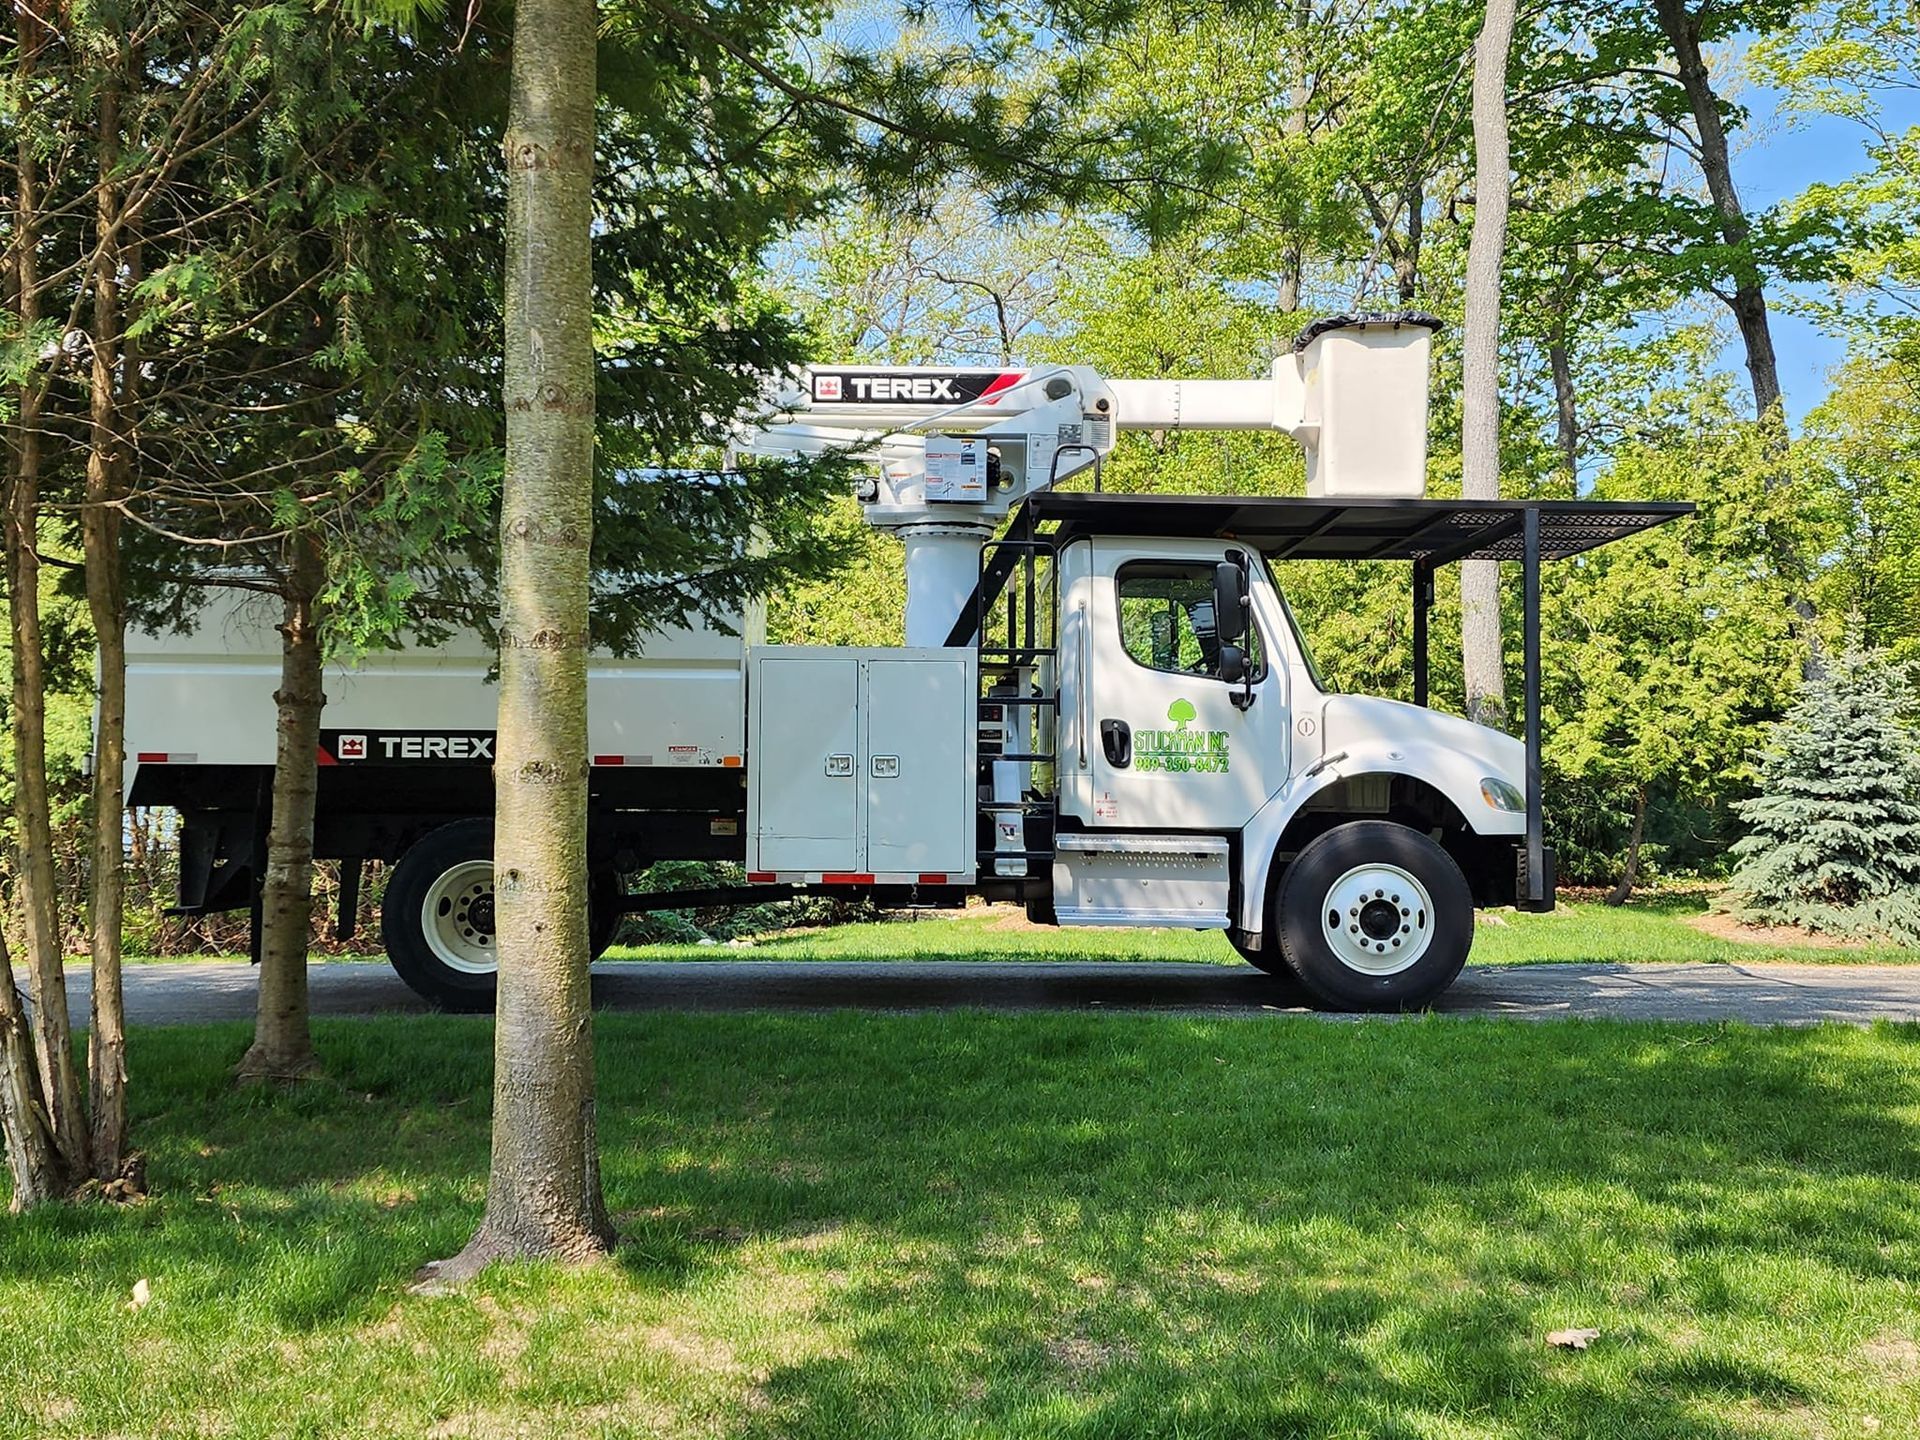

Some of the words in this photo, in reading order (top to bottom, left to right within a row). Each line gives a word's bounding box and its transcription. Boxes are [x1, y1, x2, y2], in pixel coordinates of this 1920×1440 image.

[378, 737, 494, 759] TEREX
[1134, 730, 1205, 752] STUCKMAN
[1207, 730, 1230, 752] INC
[1134, 757, 1230, 773] 989-350-8472
